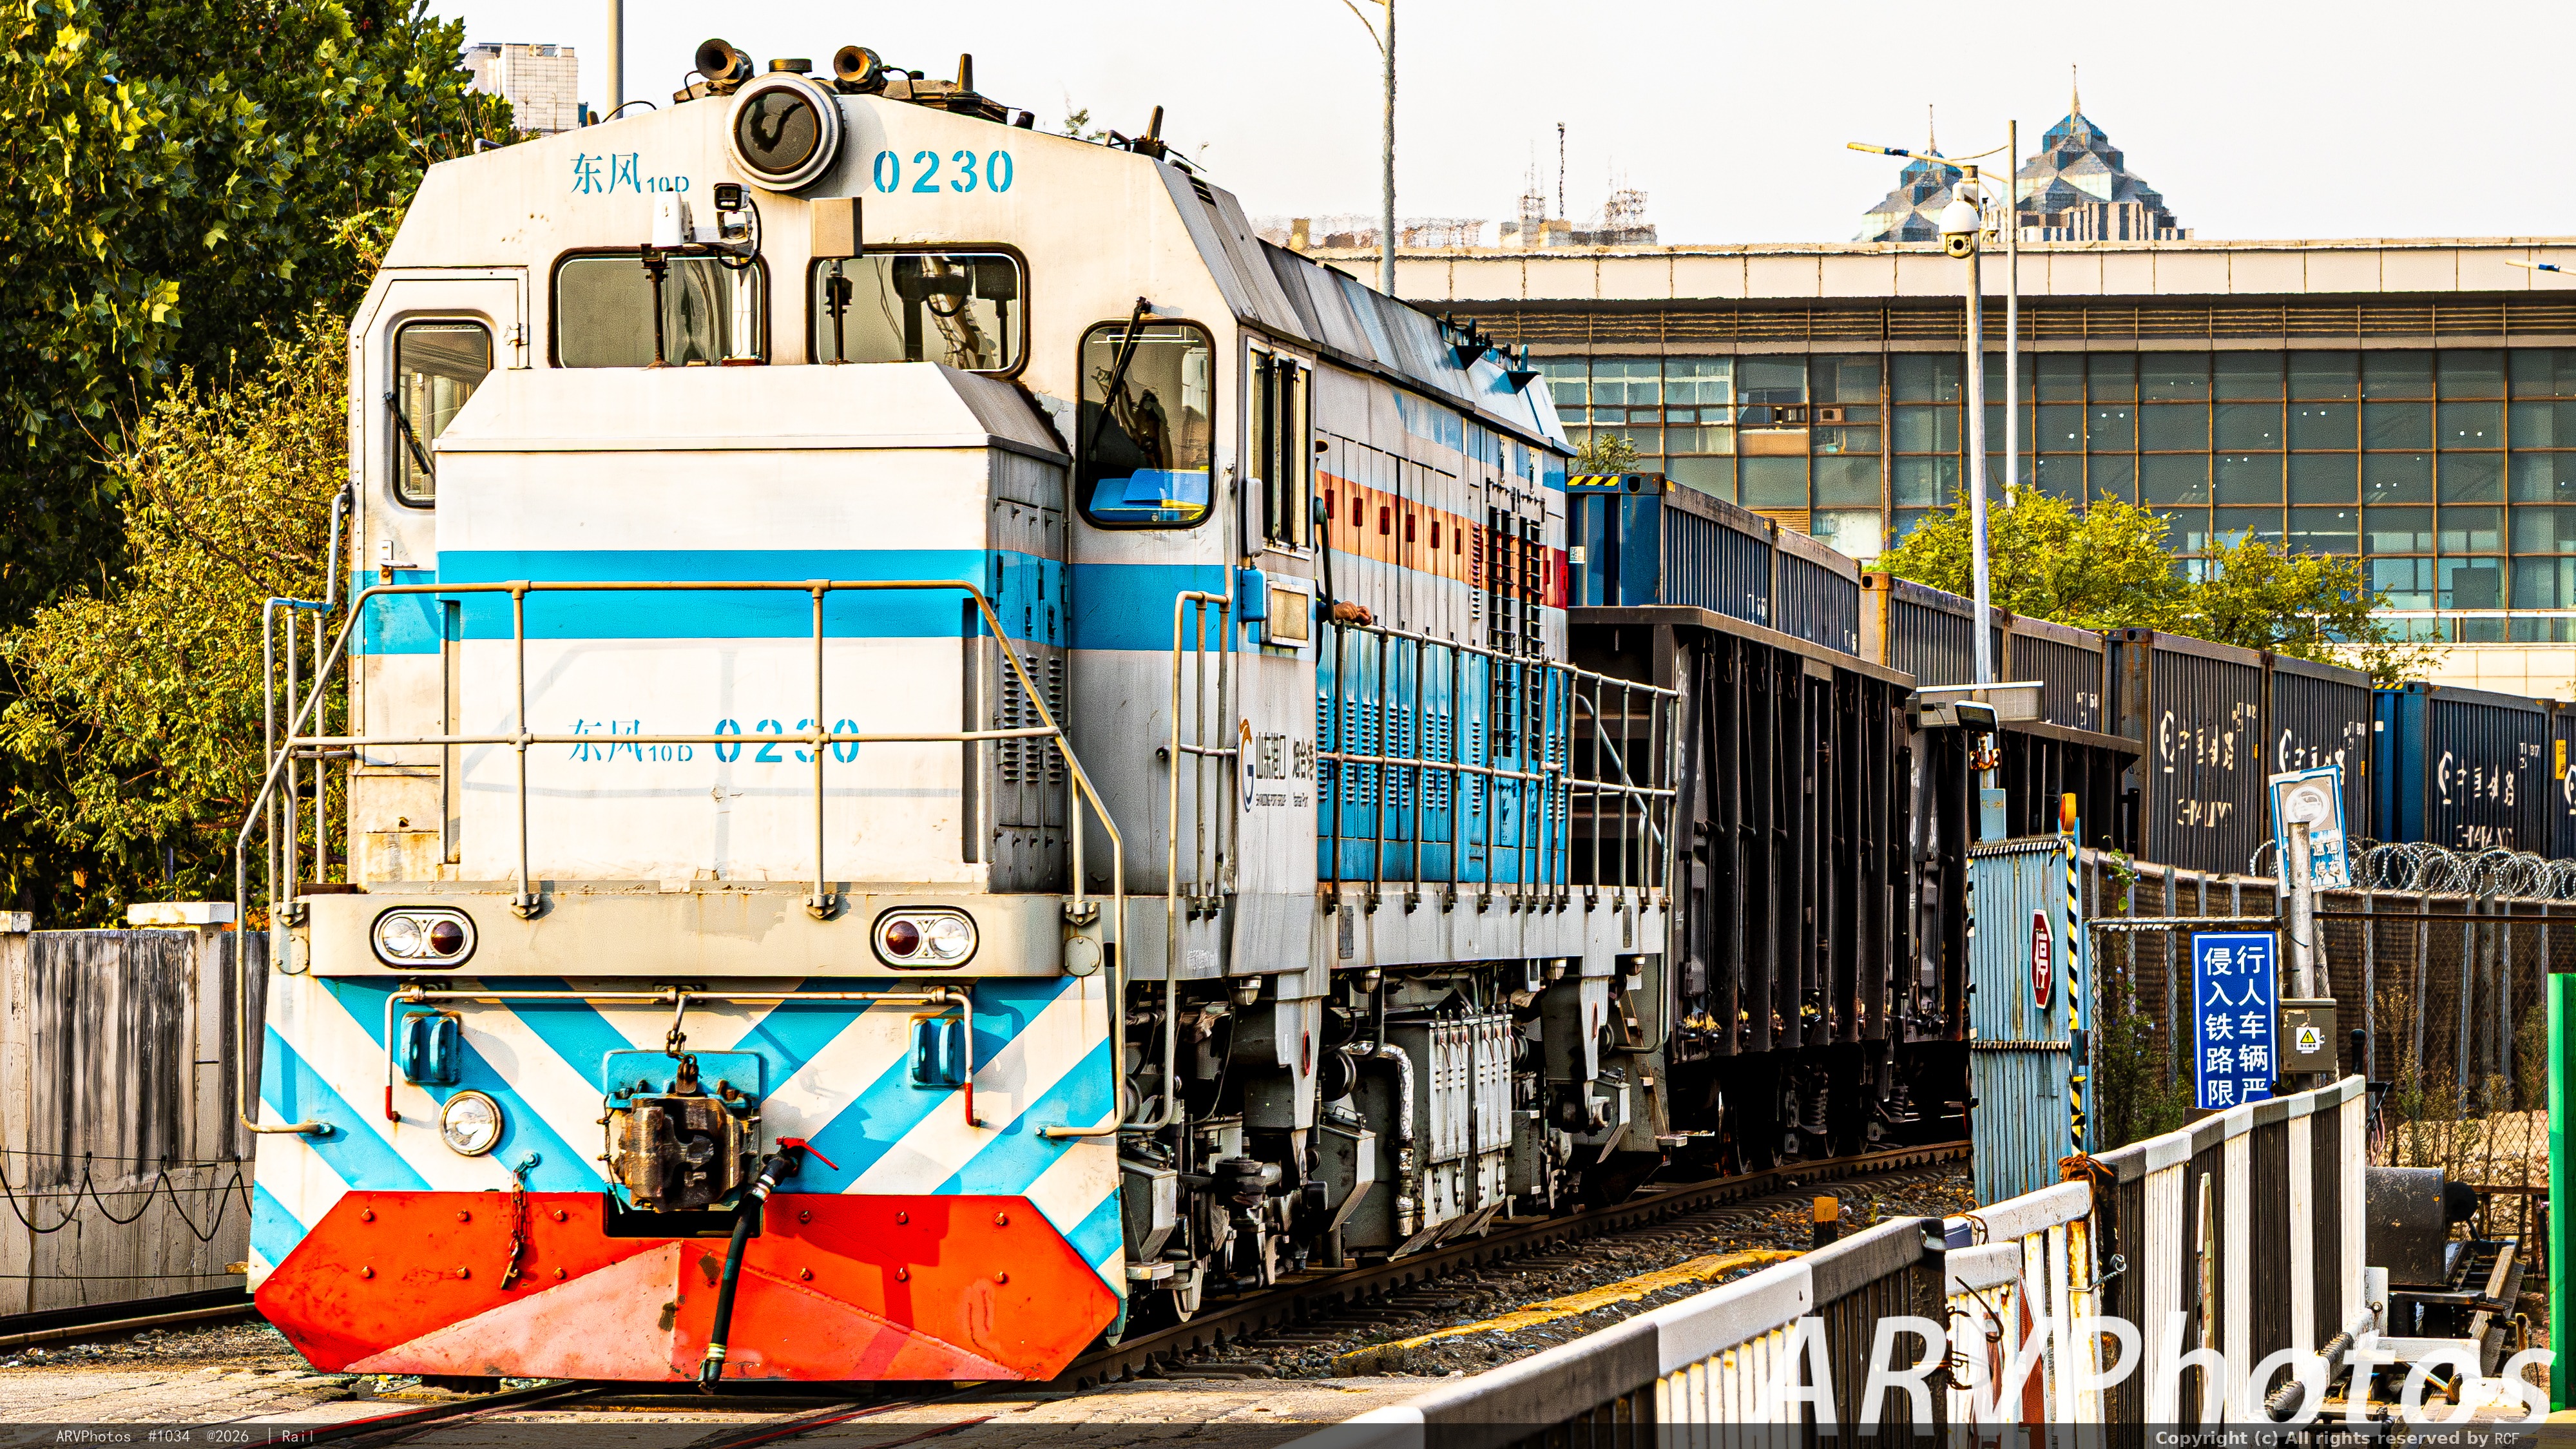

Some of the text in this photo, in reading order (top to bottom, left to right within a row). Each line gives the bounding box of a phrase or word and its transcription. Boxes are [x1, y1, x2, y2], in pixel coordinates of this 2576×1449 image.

[873, 150, 1013, 193] 0230
[2204, 948, 2235, 1106] 侵入铁路限
[2236, 945, 2268, 1104] 行人车辆严
